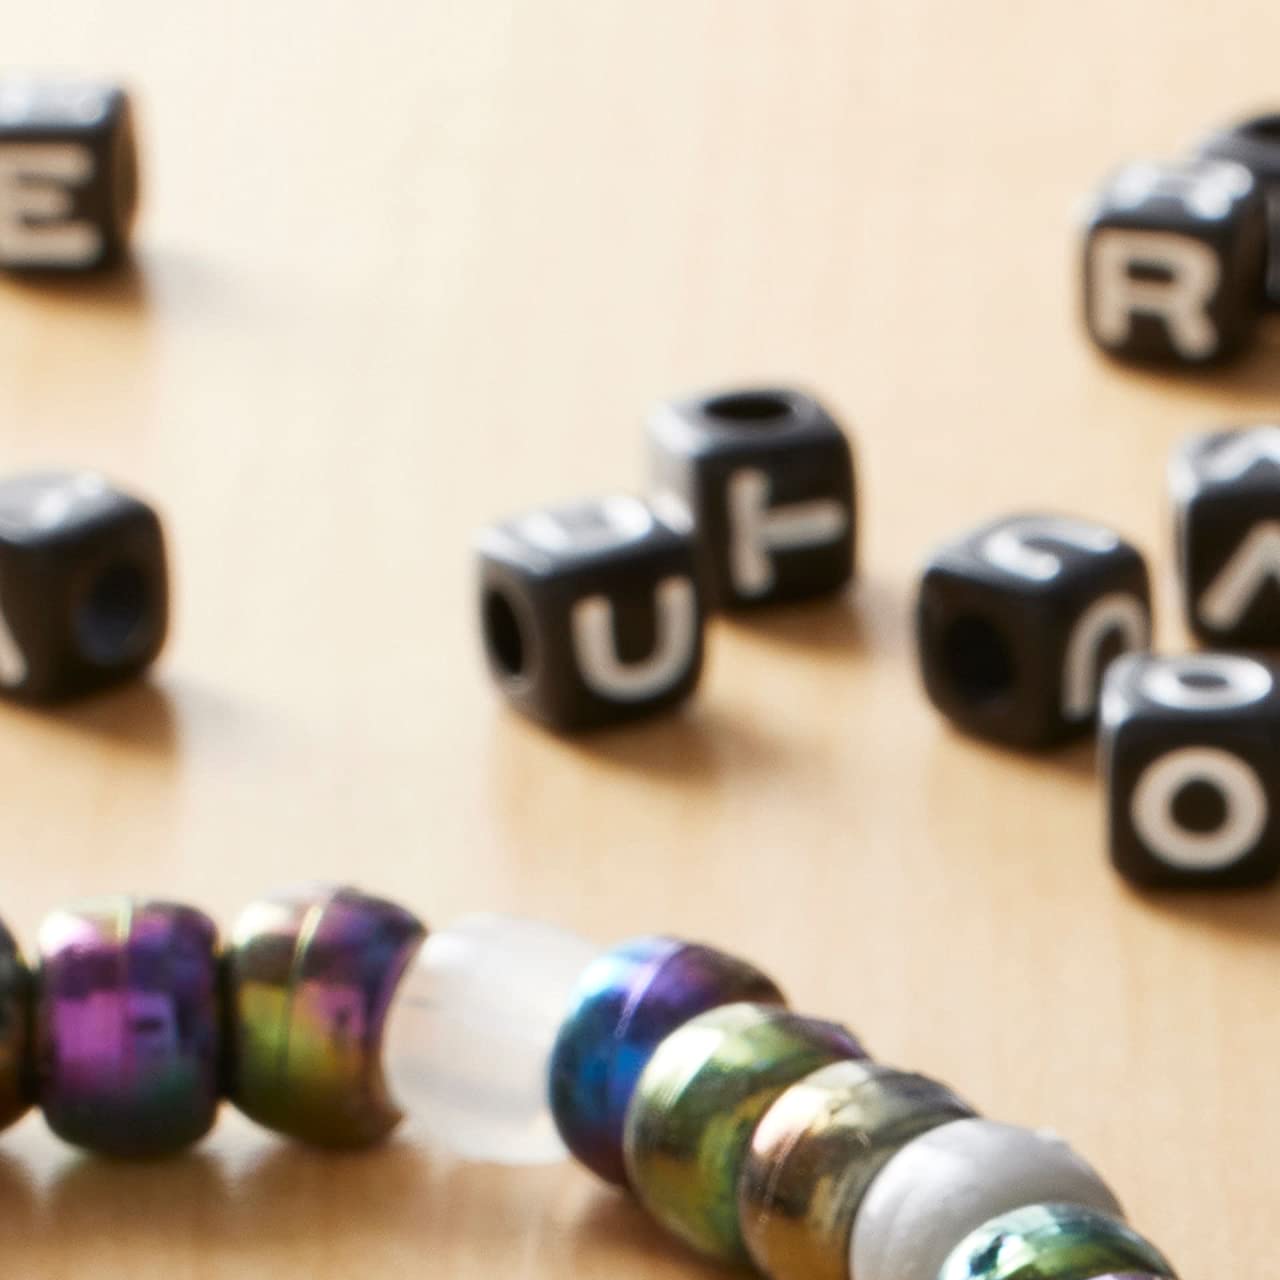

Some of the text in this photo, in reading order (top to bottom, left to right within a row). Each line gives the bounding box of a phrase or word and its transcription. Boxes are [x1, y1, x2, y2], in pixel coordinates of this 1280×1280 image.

[0, 141, 101, 269] E
[1091, 228, 1220, 360] R
[728, 470, 847, 598] T
[573, 578, 698, 702] U
[1131, 747, 1269, 871] O
